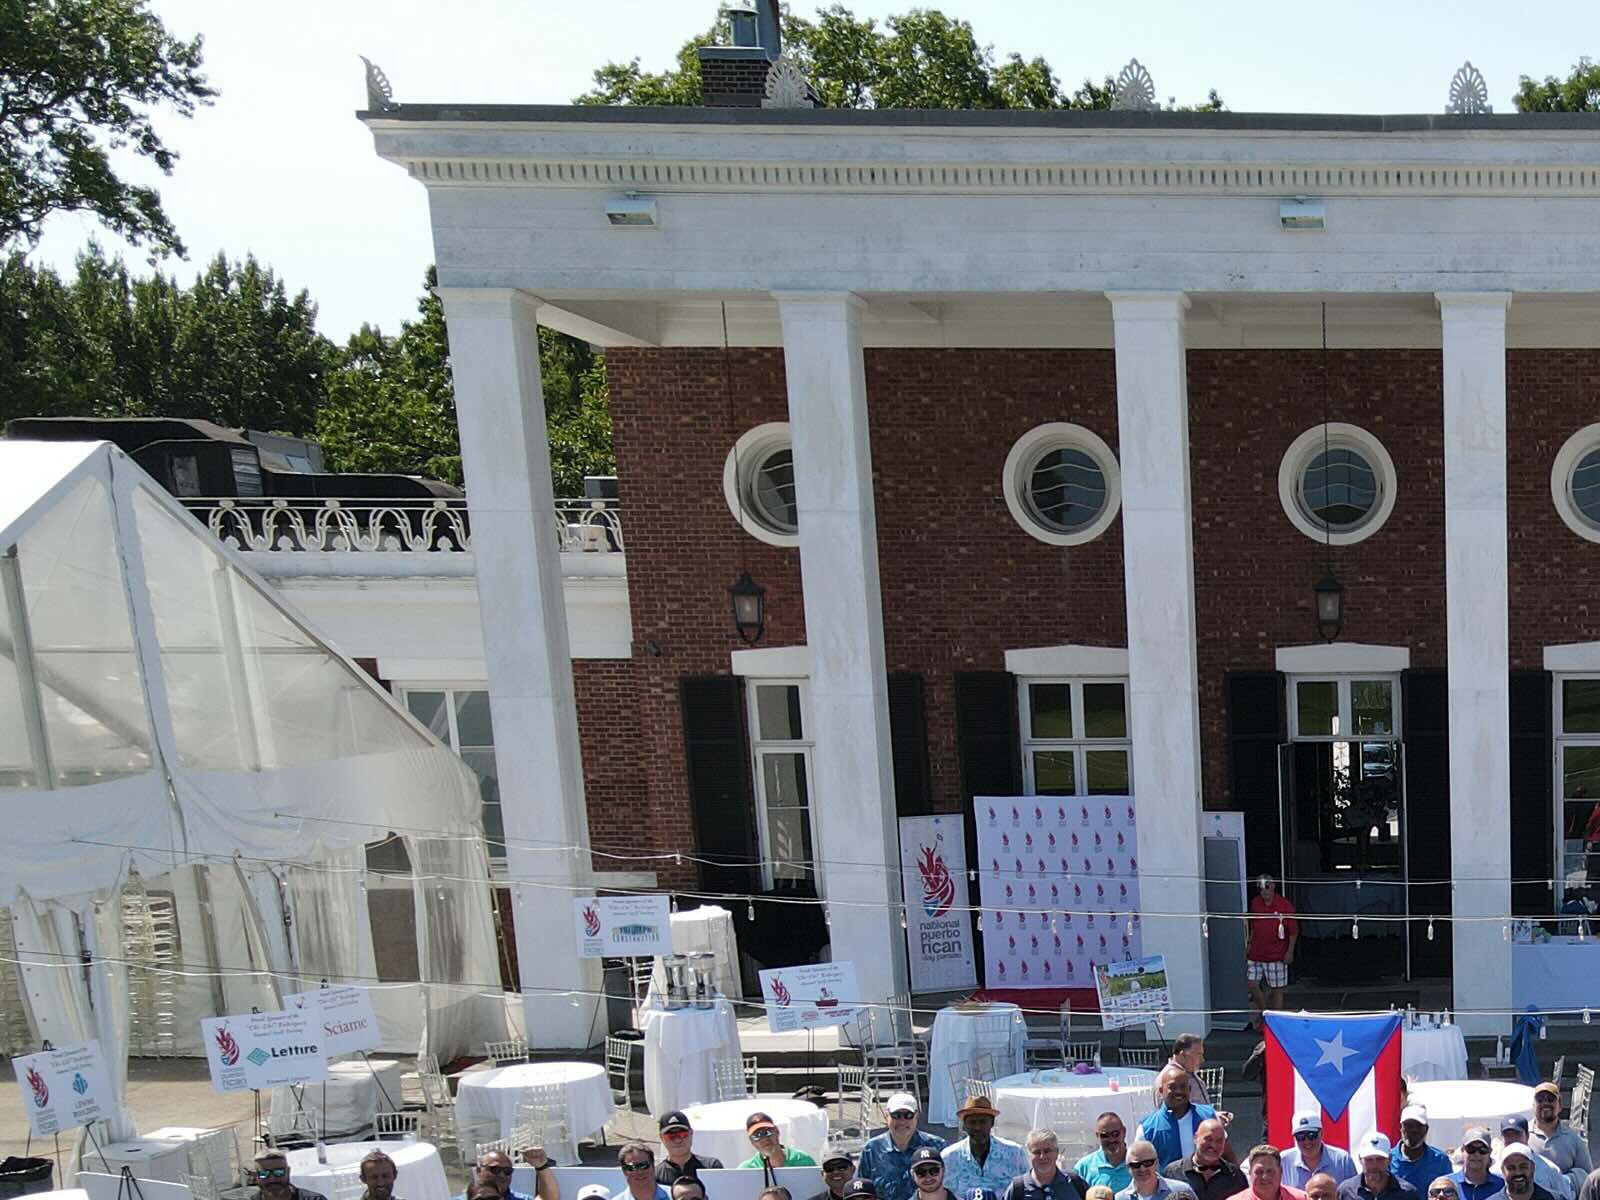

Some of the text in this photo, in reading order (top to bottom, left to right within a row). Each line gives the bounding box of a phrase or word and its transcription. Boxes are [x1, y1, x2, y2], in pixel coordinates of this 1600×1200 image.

[920, 919, 960, 931] national
[921, 929, 960, 942] puerto
[921, 940, 962, 954] rican
[323, 1018, 369, 1038] Sciame
[271, 1044, 319, 1058] Lettire
